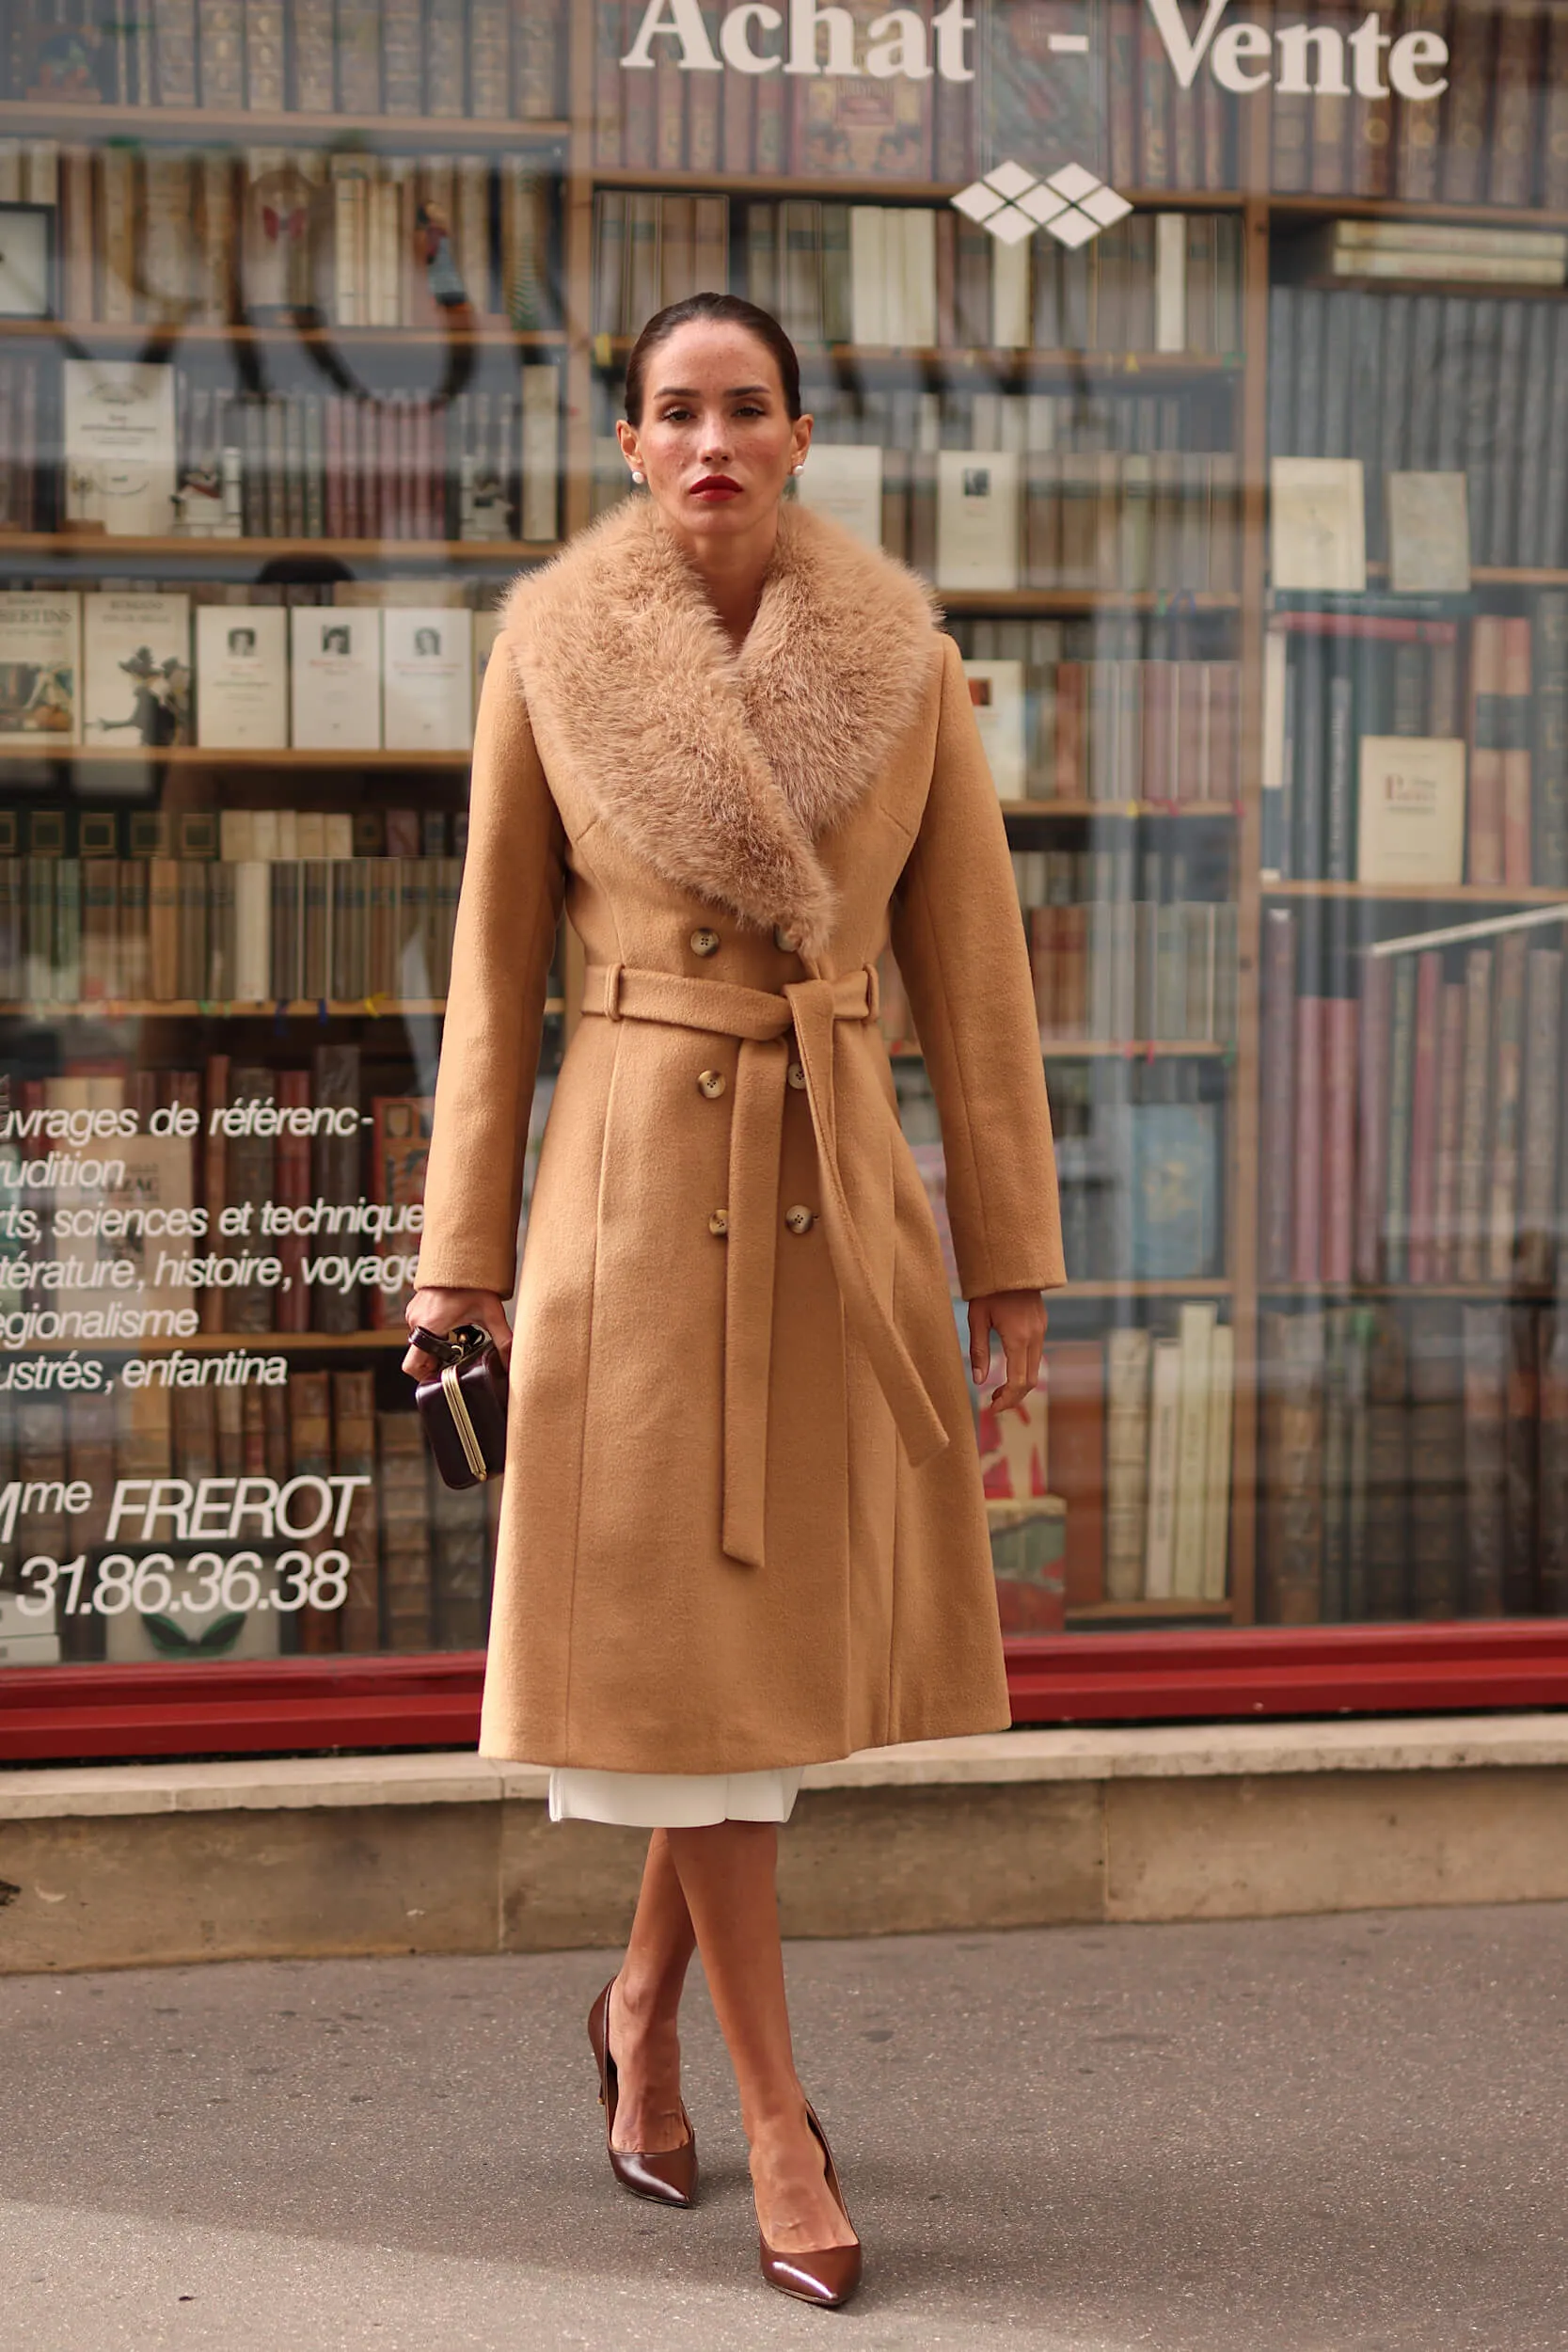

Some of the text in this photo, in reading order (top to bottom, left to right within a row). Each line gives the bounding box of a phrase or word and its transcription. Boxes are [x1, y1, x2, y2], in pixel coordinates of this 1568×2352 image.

[620, 0, 1449, 101] Achat - Vente
[150, 1101, 199, 1137] de
[52, 1200, 208, 1238] sciences
[217, 1200, 254, 1236] et
[260, 1197, 423, 1243] technique
[154, 1250, 292, 1292] histoire,
[0, 1301, 198, 1350] gionalisme
[122, 1349, 288, 1388] enfantina
[105, 1474, 372, 1541] FREROT
[15, 1549, 351, 1615] 31.86.36.38
